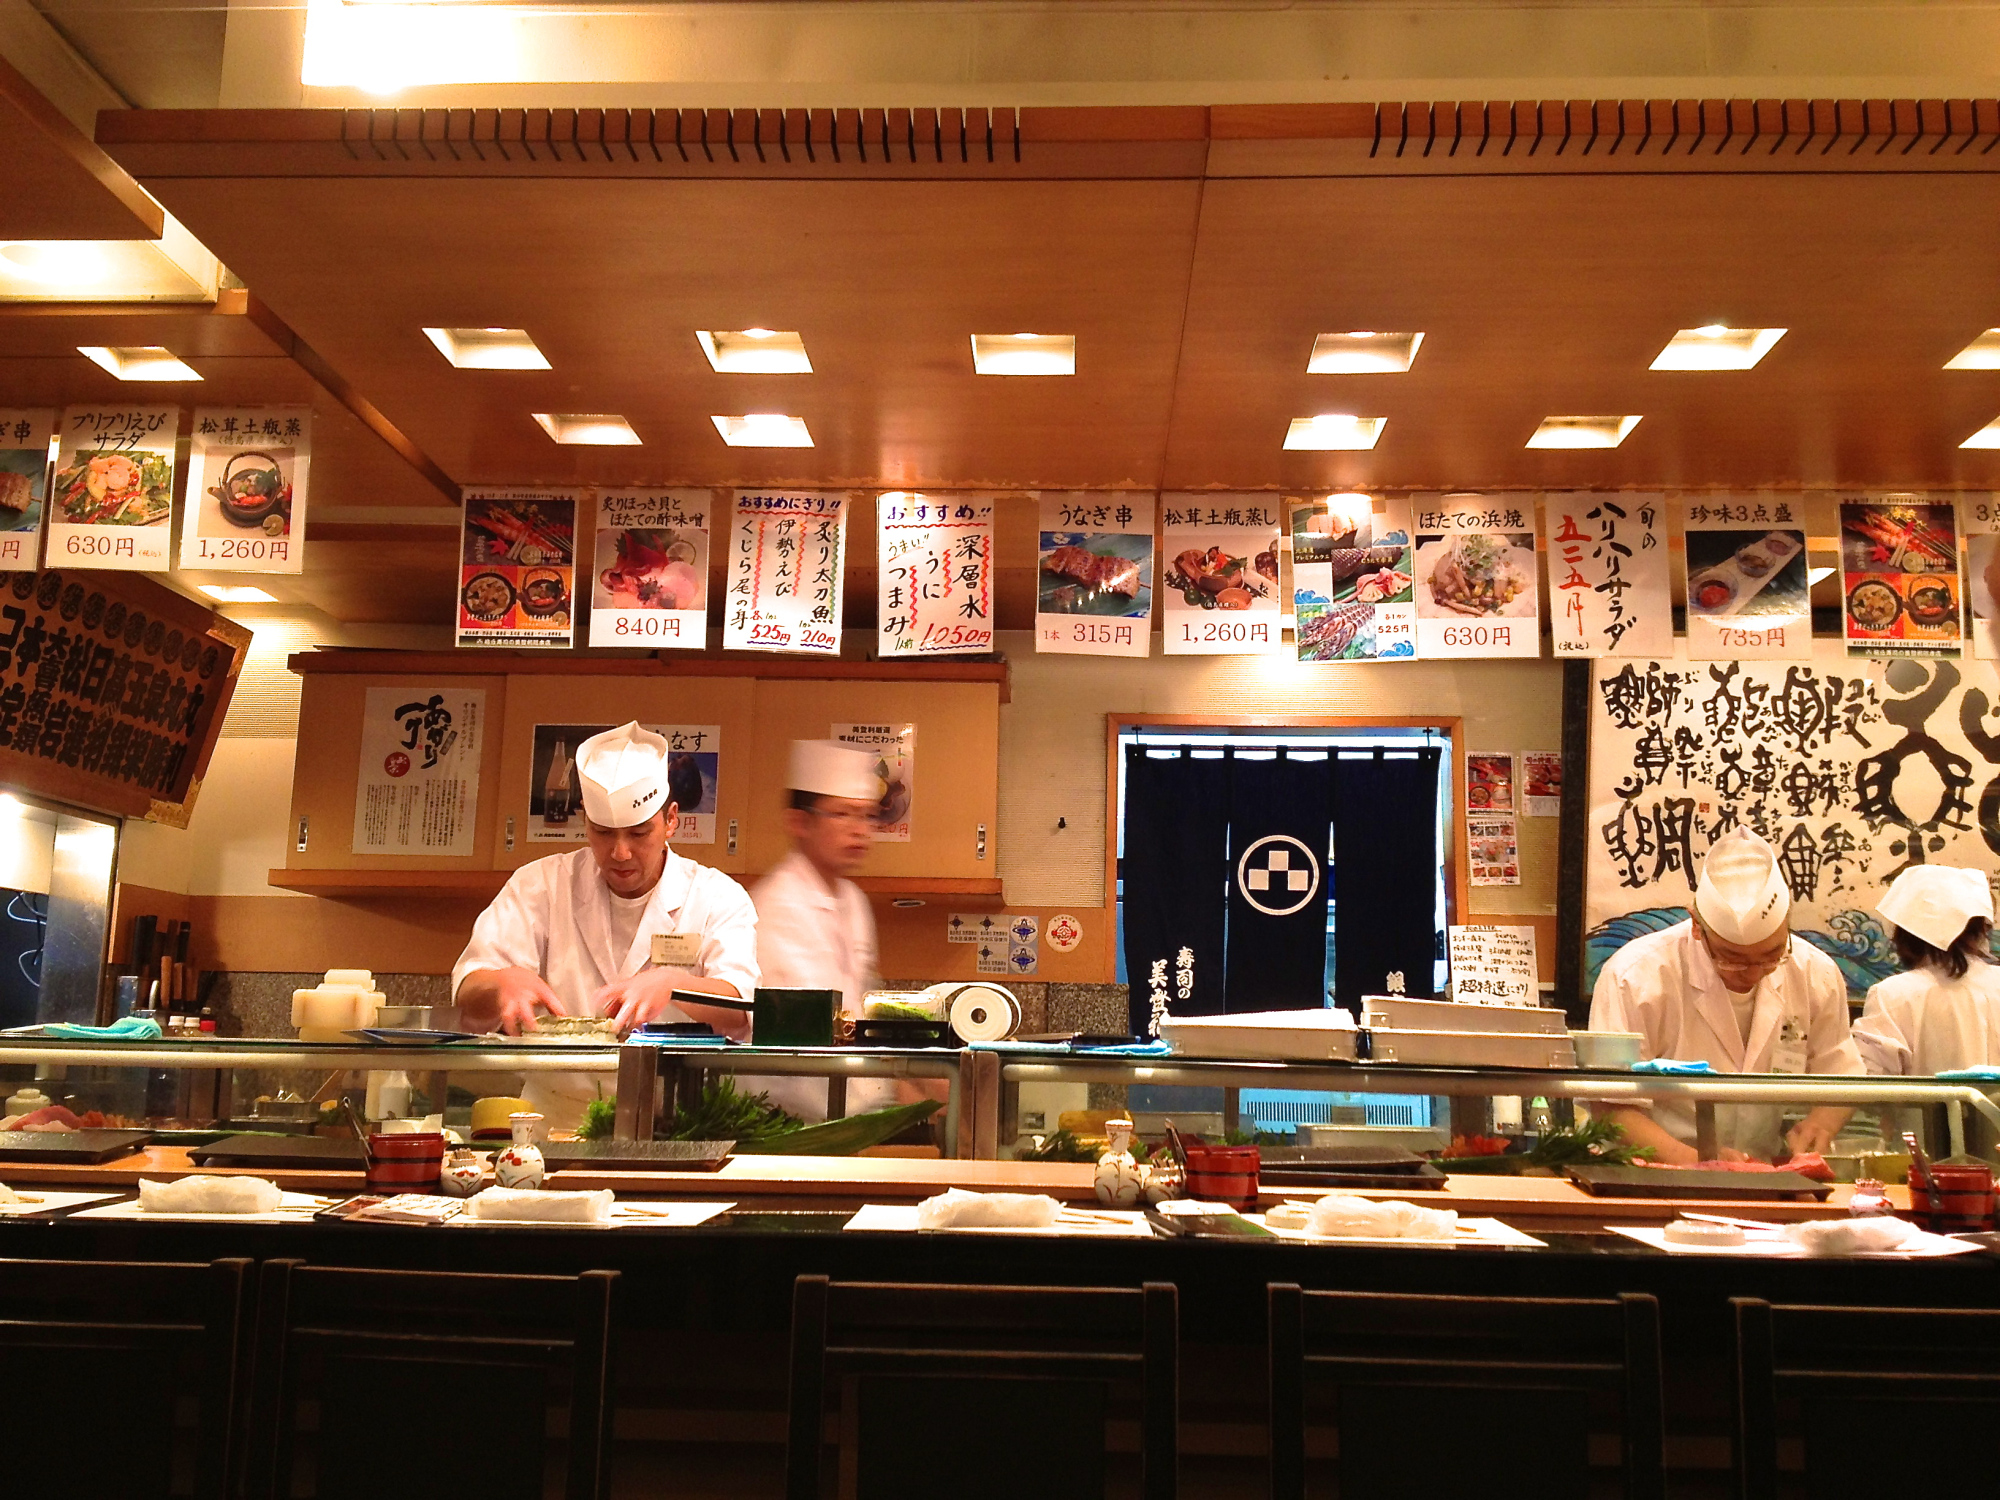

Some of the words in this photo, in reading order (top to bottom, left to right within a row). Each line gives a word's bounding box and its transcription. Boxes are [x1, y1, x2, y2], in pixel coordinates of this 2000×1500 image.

[73, 412, 167, 433] プリプリえび
[199, 416, 301, 437] 松茸土瓶蒸
[93, 432, 146, 452] サラダ
[601, 496, 683, 512] 炙りほっき貝と
[1690, 505, 1794, 525] 珍味3点盛
[610, 512, 705, 528] ほたての酢味噌
[1059, 503, 1134, 529] うなぎ串
[1163, 507, 1277, 527] 松茸土瓶蒸し
[1418, 510, 1525, 530] ほたての浜焼
[1636, 502, 1657, 551] 旬の
[67, 536, 134, 559] 630円
[198, 540, 289, 562] 1,260円
[775, 519, 797, 597] 伊勢えび
[730, 520, 754, 631] くじら尾の身
[812, 521, 834, 625] 炙り太刀魚
[921, 550, 940, 600] うに
[953, 534, 987, 620] 深層水
[1586, 502, 1637, 651] ハリハリサラダ
[884, 567, 910, 636] つまみ
[614, 616, 681, 639] 840円
[750, 623, 791, 643] 525円
[801, 629, 836, 645] 210円
[1043, 631, 1061, 641] 1本
[1073, 623, 1133, 646] 315円
[1181, 622, 1269, 644] 1,260円
[1377, 624, 1410, 636] 525円
[1443, 626, 1511, 648] 630円
[1718, 626, 1786, 649] 735円
[655, 730, 709, 752] なす
[1176, 946, 1195, 999] 寿司の
[1386, 970, 1406, 998] 銀
